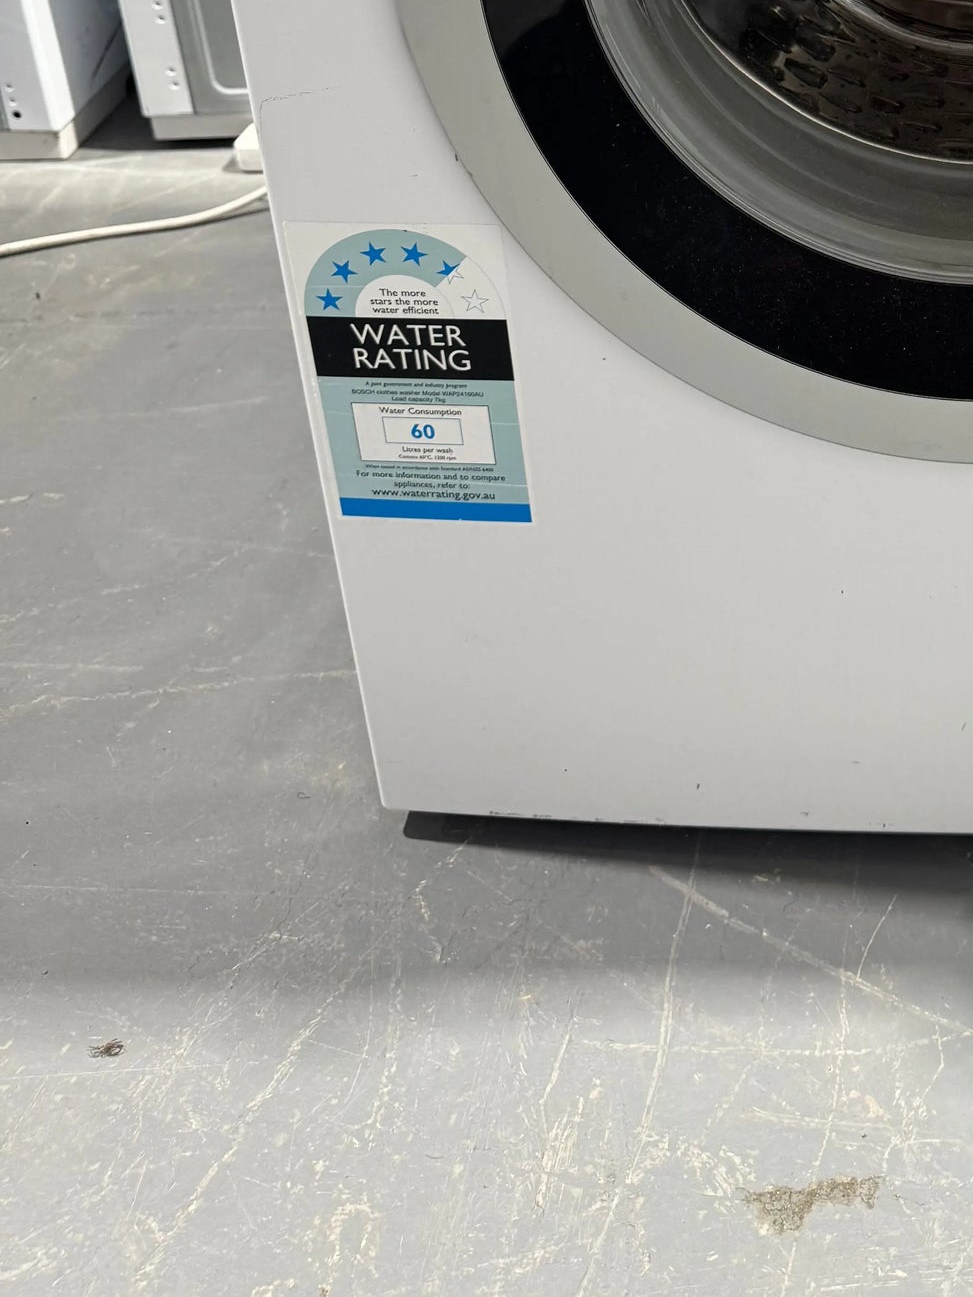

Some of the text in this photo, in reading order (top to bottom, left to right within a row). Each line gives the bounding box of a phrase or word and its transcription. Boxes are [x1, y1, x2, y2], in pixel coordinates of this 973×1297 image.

[379, 288, 399, 297] The
[395, 298, 411, 306] the
[402, 306, 439, 315] efficient
[350, 323, 467, 347] WATER
[352, 348, 472, 371] RATING
[408, 408, 462, 416] Consumption
[411, 423, 435, 439] 60
[356, 469, 370, 477] For
[395, 472, 441, 480] information
[471, 475, 506, 483] compare
[371, 489, 496, 501] www.waterrating.gov.au
